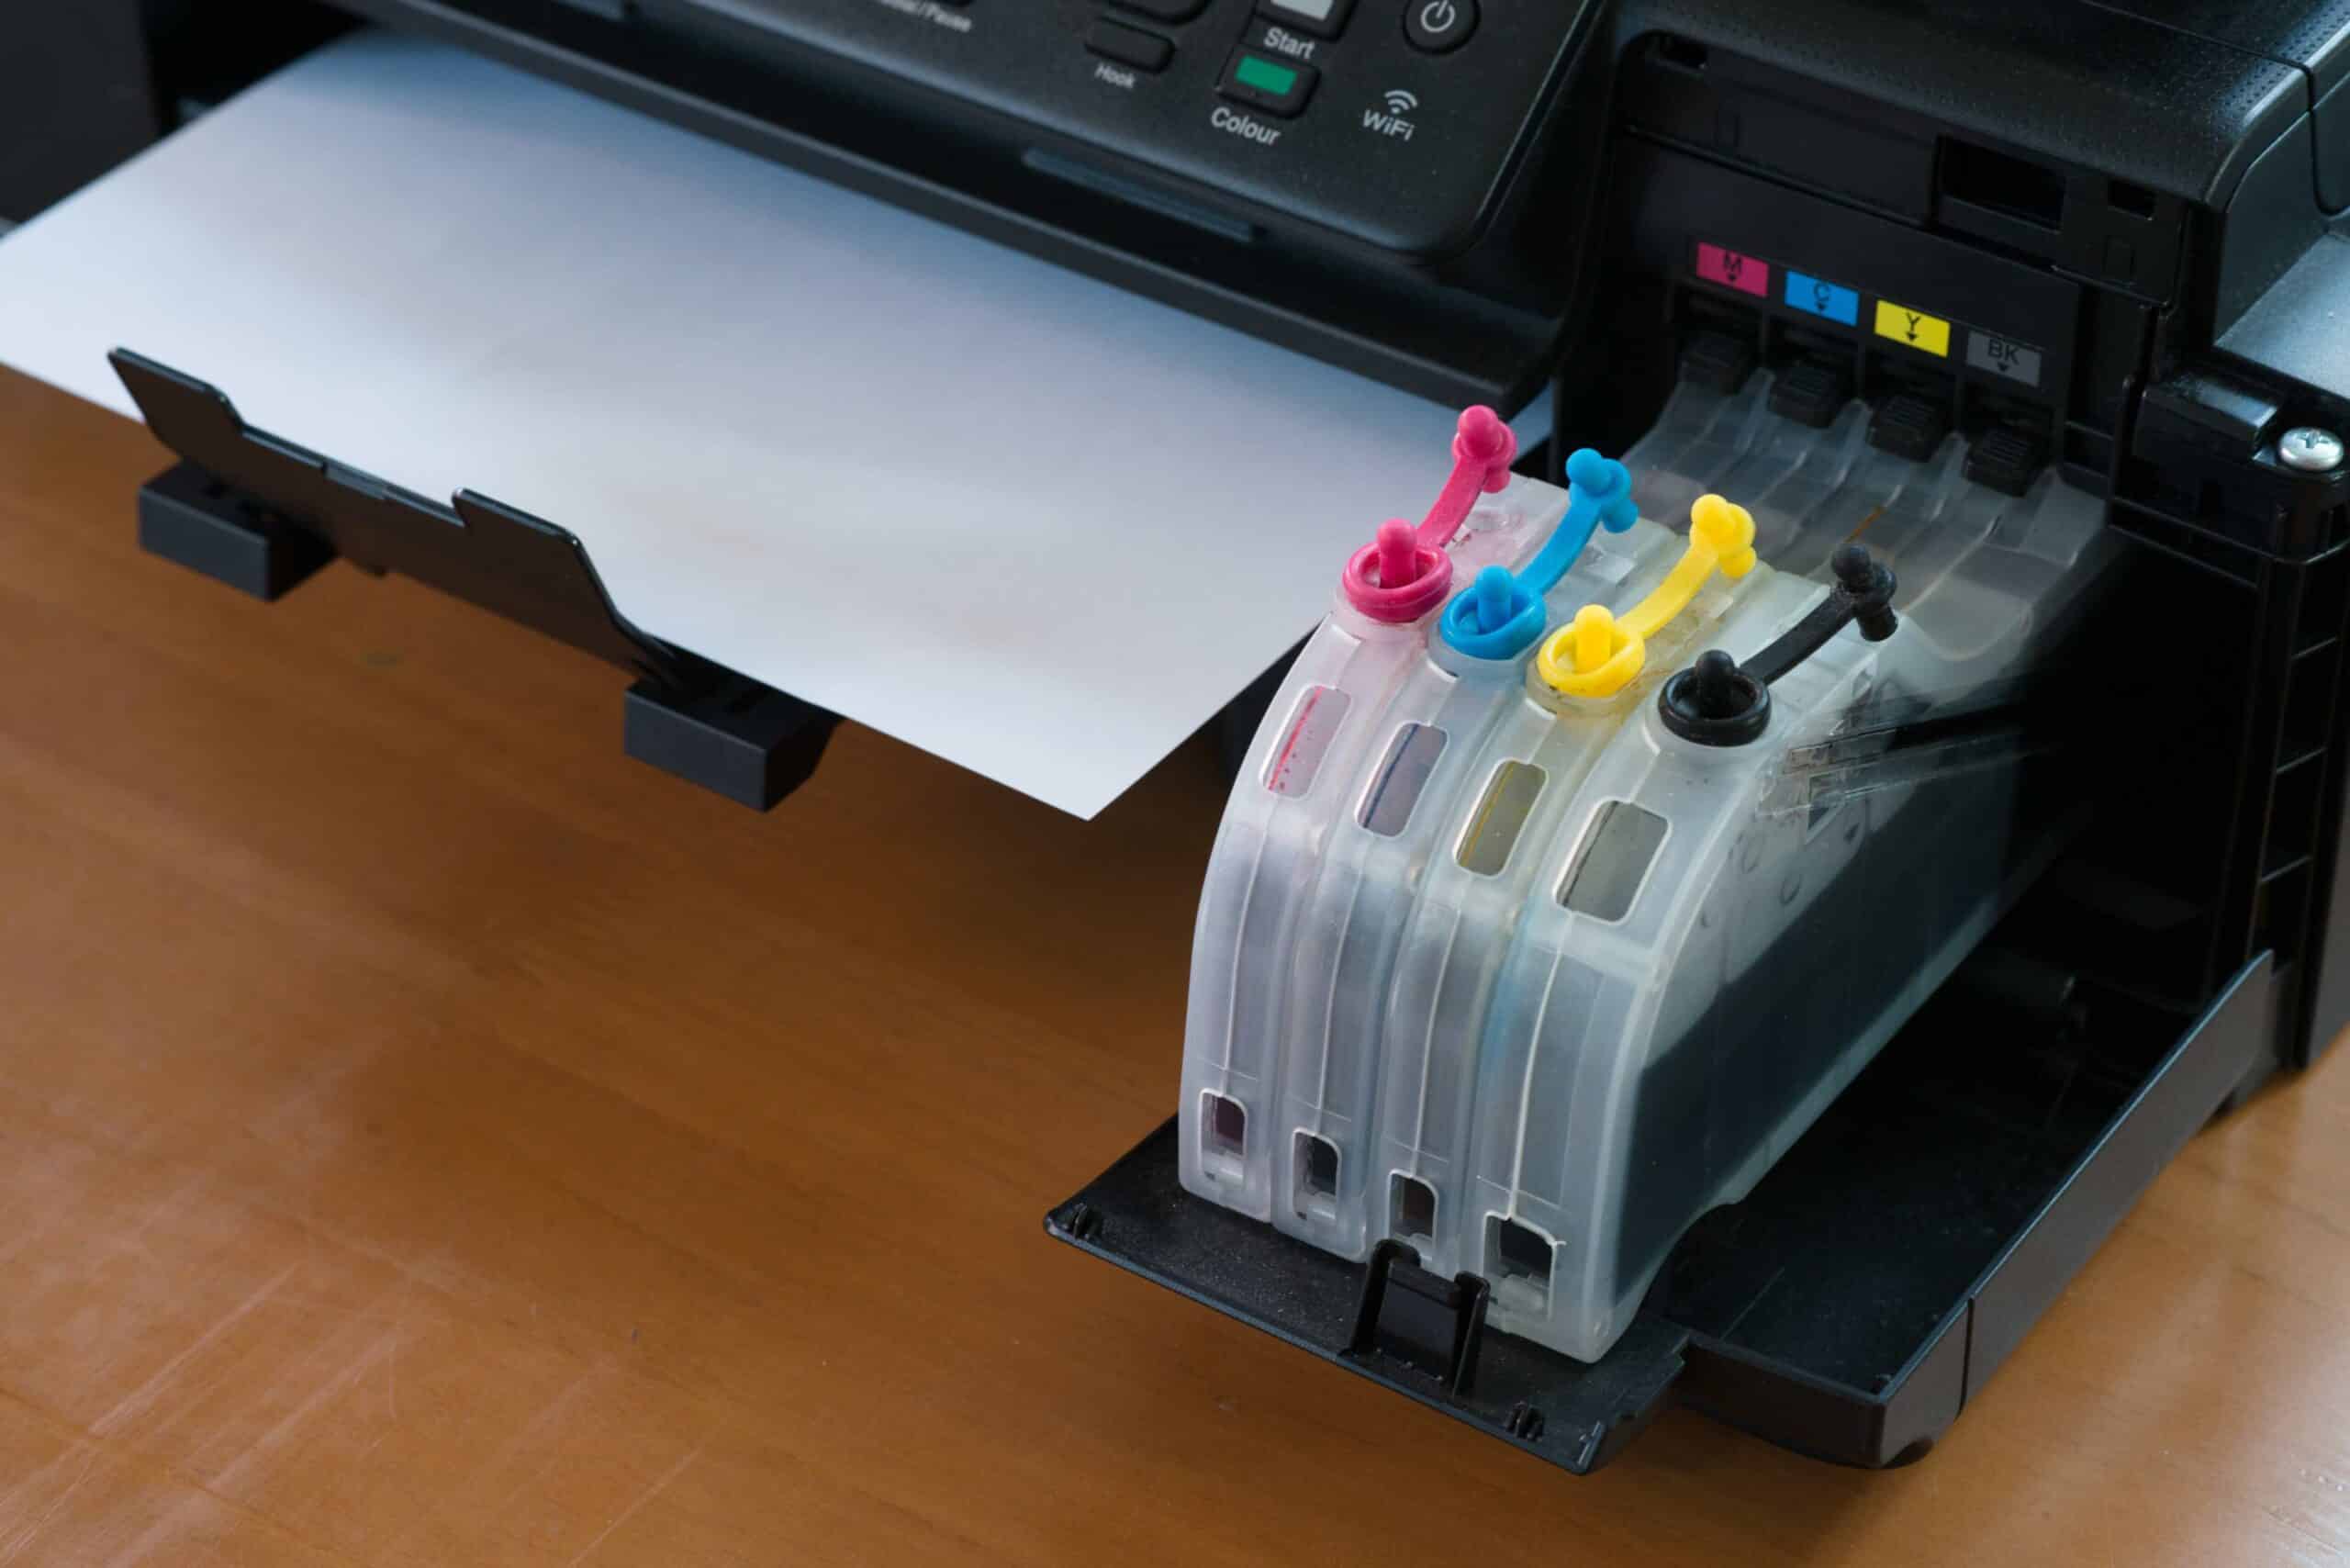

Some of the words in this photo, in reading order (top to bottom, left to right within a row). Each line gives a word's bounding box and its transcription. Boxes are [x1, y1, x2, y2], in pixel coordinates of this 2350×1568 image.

[1263, 26, 1315, 60] Start
[1211, 106, 1281, 145] Colour
[1362, 108, 1415, 141] WiFi
[1722, 252, 1742, 274] M
[1813, 282, 1830, 302] C
[1906, 311, 1921, 331] Y
[1987, 338, 2020, 364] BK
